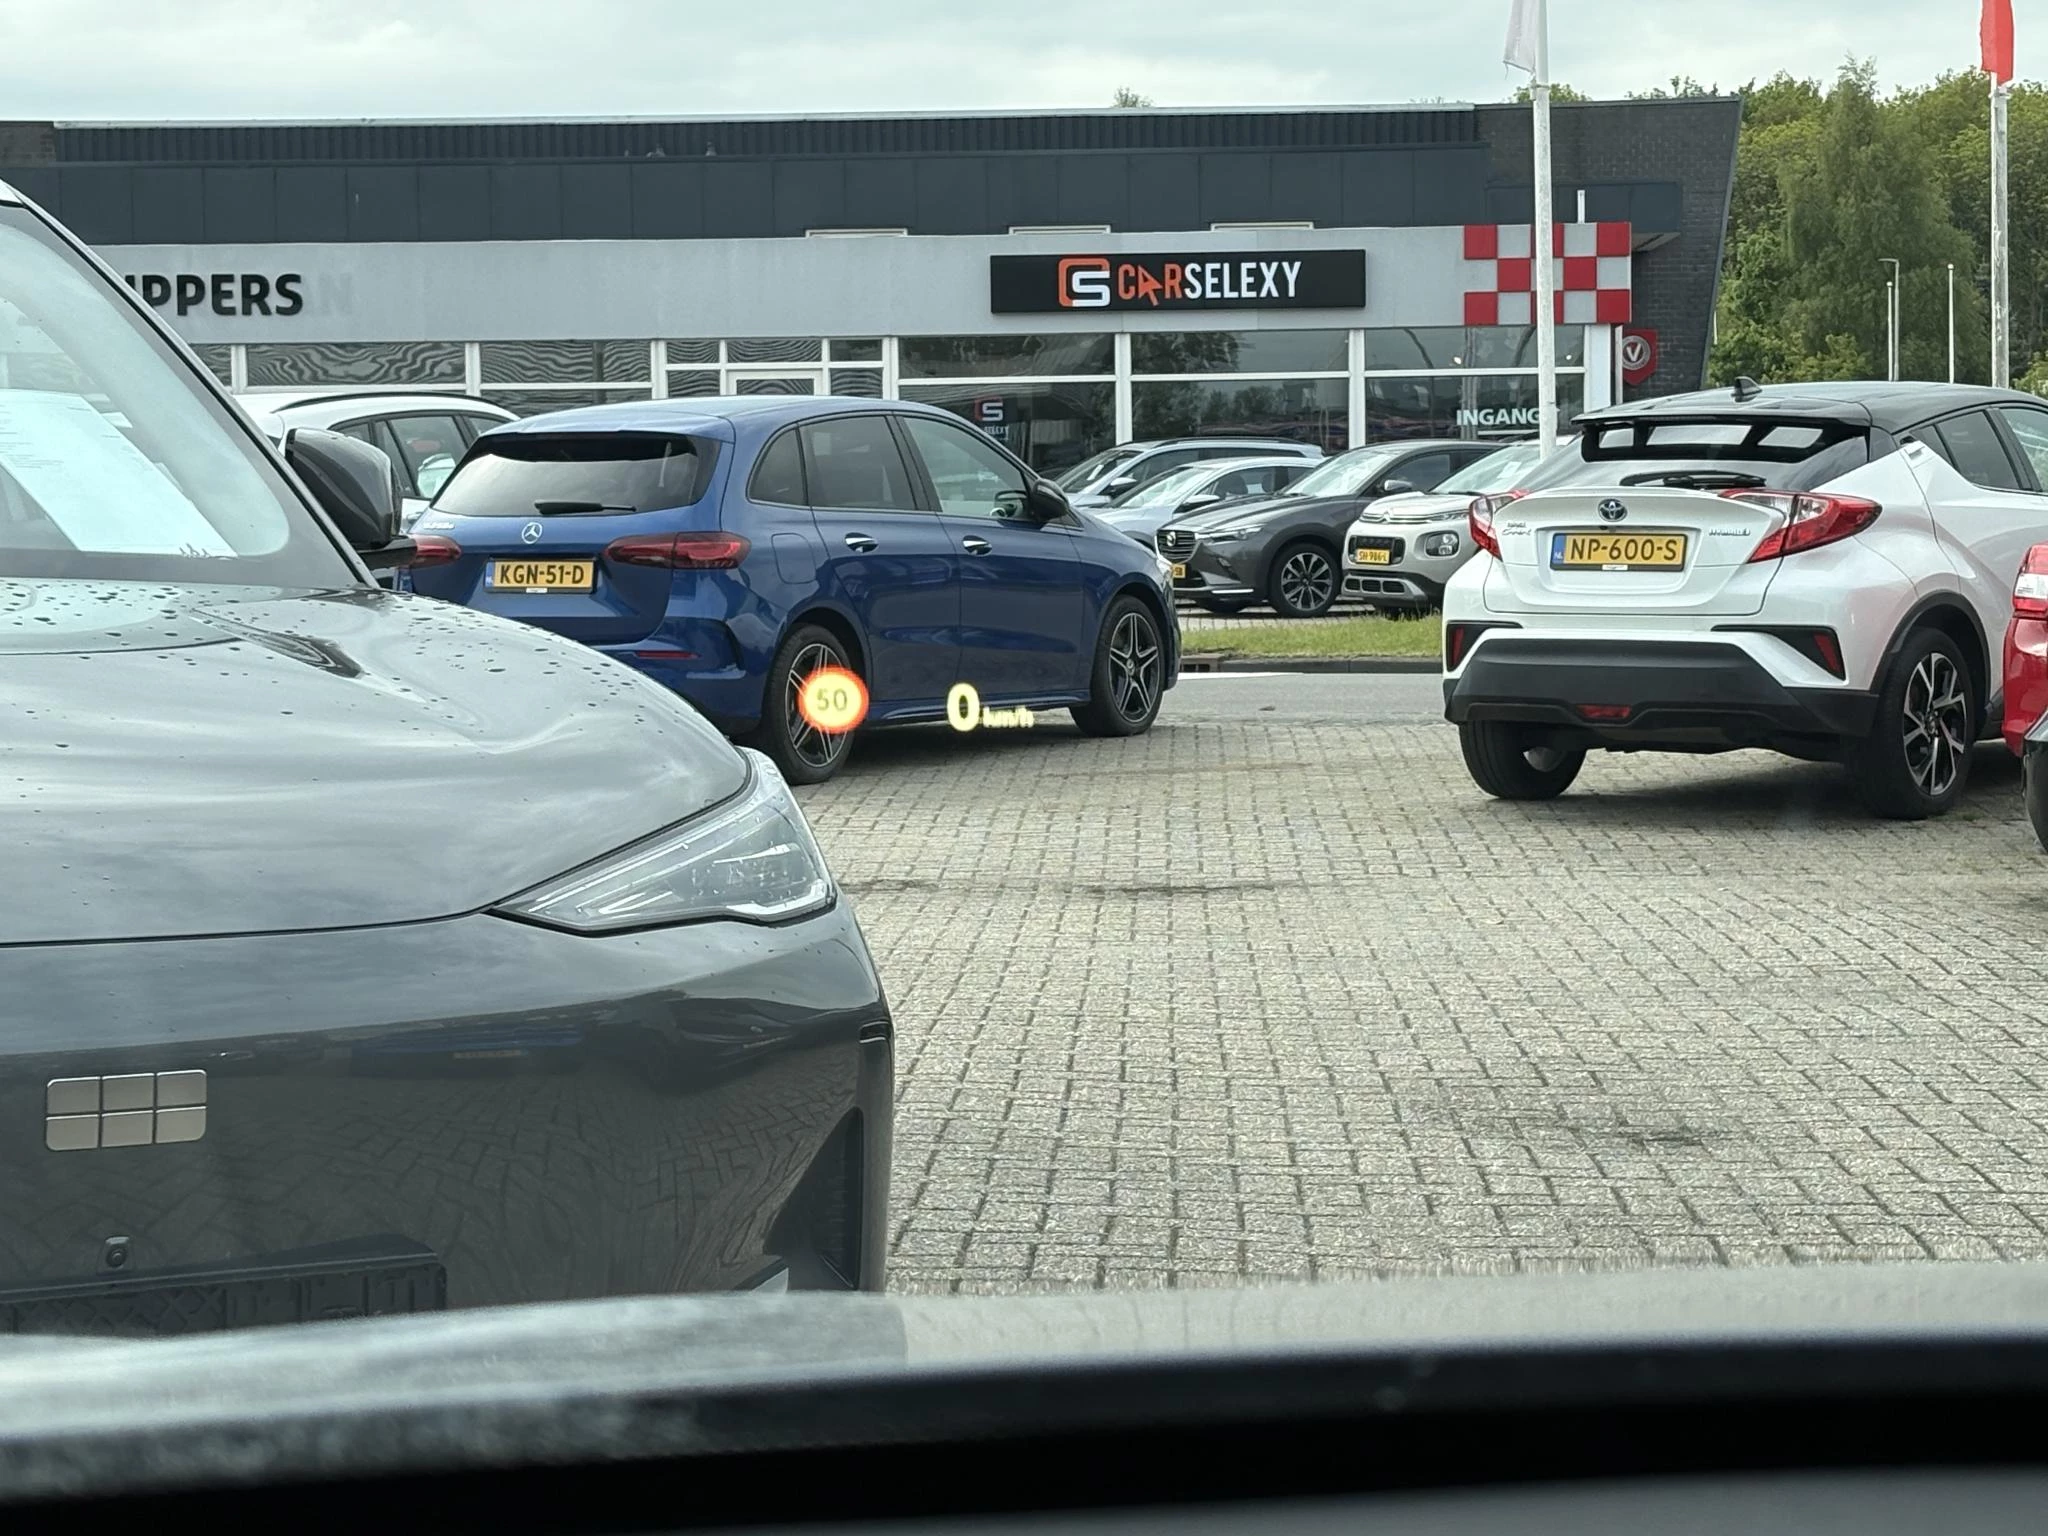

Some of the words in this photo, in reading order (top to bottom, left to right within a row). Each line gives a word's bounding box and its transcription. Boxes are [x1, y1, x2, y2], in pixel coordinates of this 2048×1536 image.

[1118, 261, 1302, 306] CARSELEXY
[1456, 407, 1540, 425] INGANG
[1571, 538, 1677, 561] NP-600-S
[500, 564, 584, 584] KGN-51-D
[816, 688, 848, 711] 50
[947, 682, 980, 732] 0
